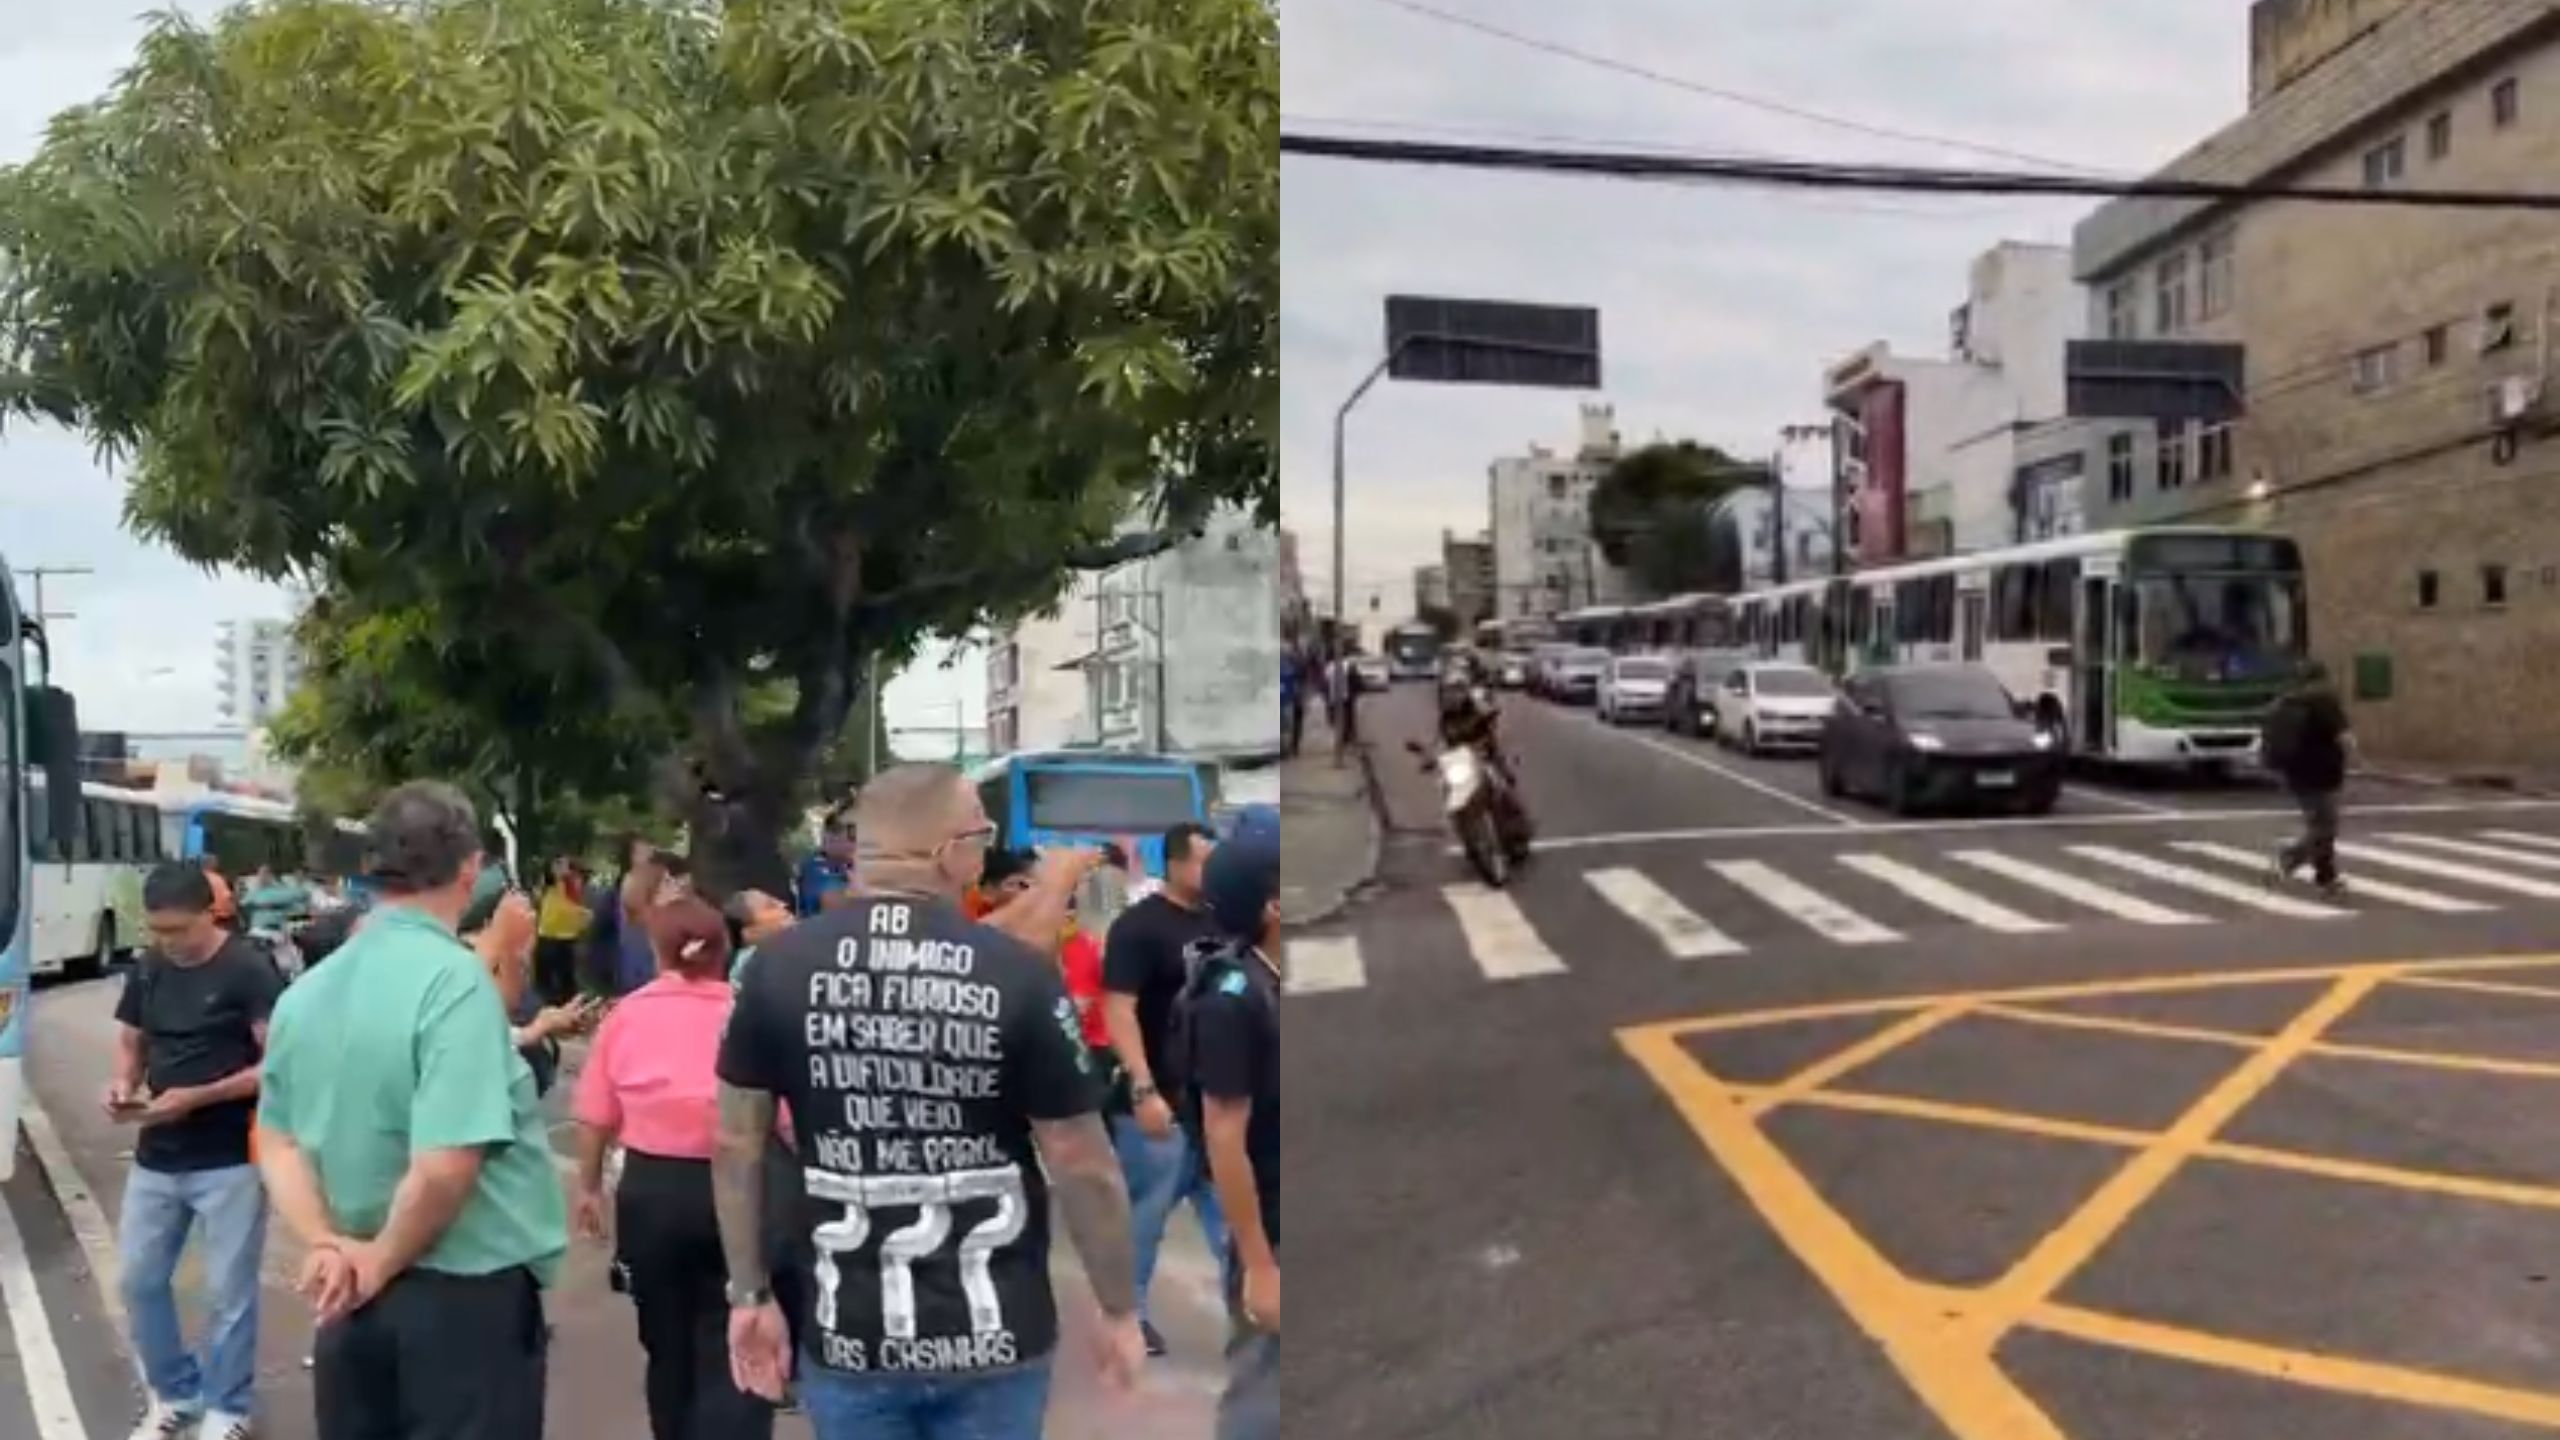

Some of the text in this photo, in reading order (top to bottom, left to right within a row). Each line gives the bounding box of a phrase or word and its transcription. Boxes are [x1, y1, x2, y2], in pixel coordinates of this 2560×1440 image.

[869, 903, 910, 934] AB
[837, 936, 973, 975] O INIMIGO
[810, 972, 999, 1019] FICA FURIOSO
[805, 1012, 1002, 1059] EM SABER QUE
[810, 1054, 999, 1097] A DIFICULDADE
[844, 1094, 963, 1130] QUE VEIO
[814, 1128, 862, 1171] NÃO
[876, 1137, 919, 1170] ME
[823, 1331, 1017, 1371] DAS CASINHAS
